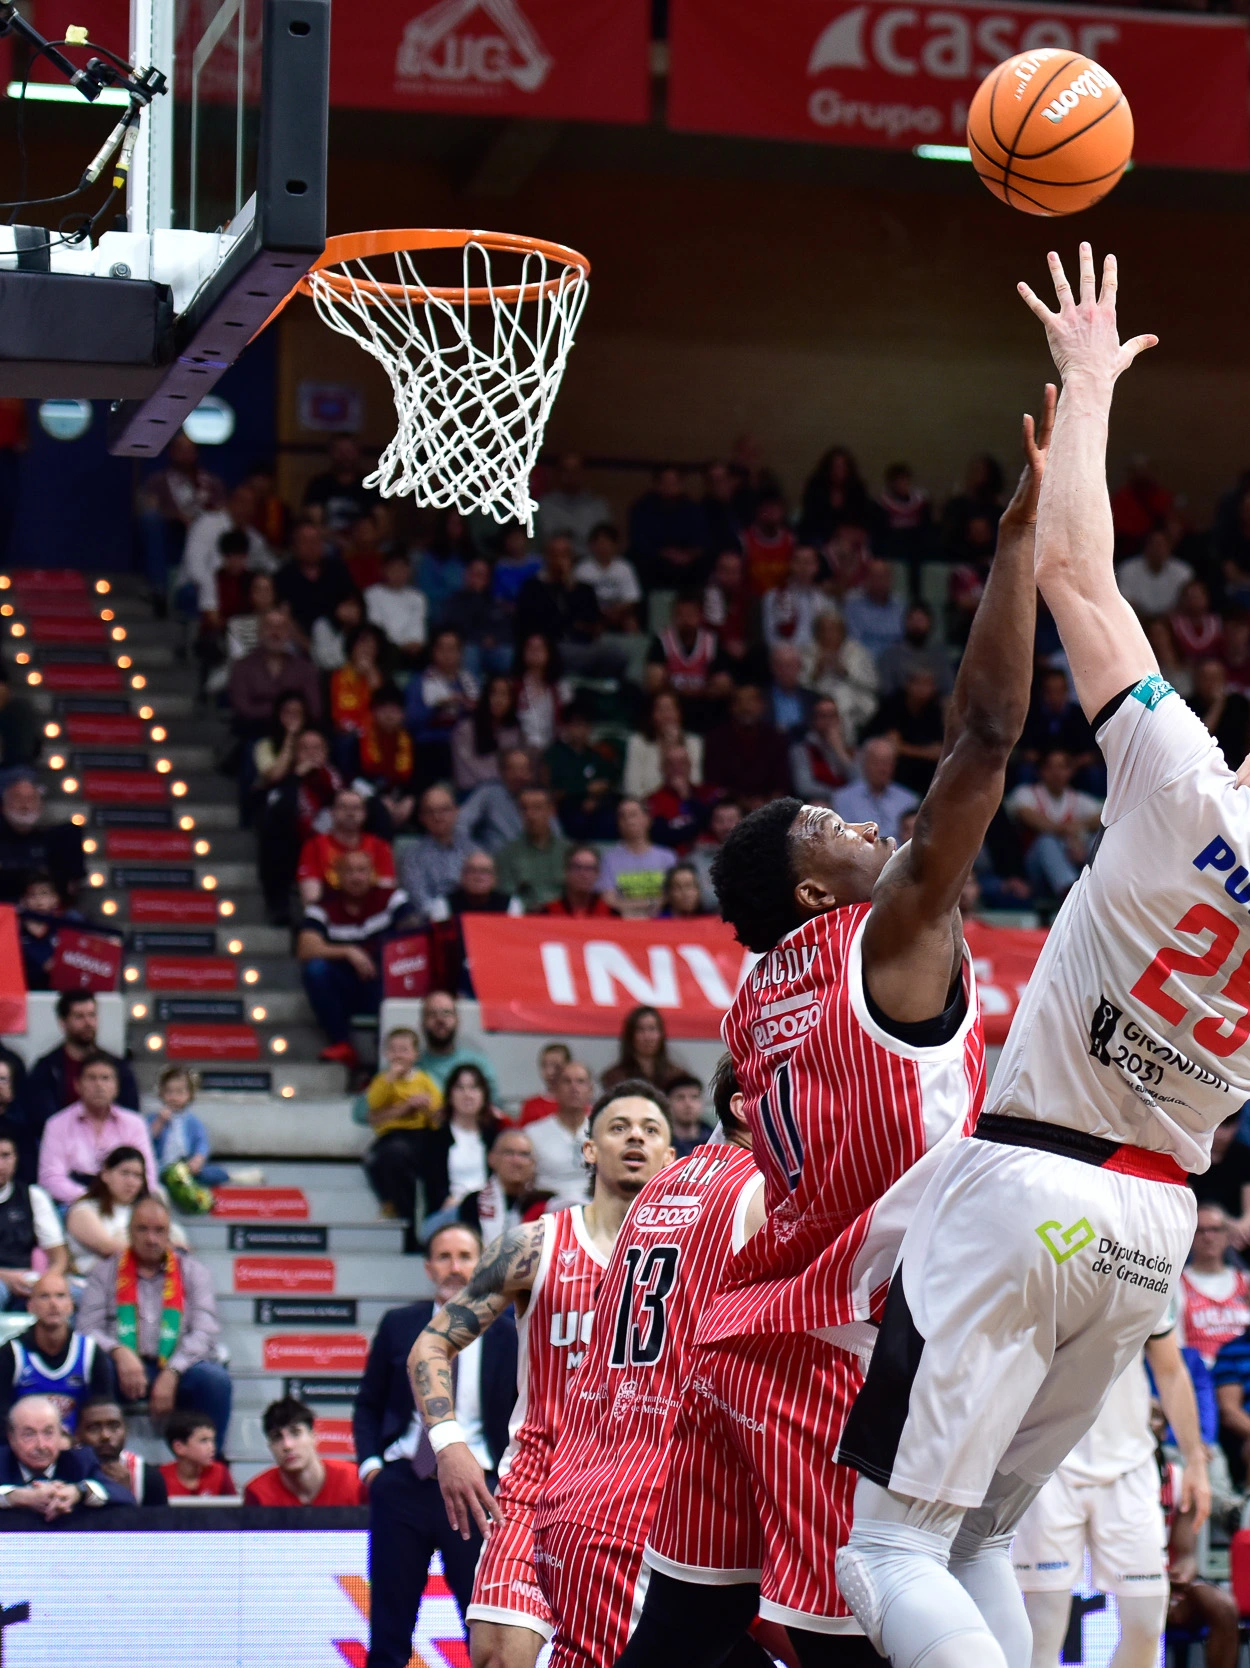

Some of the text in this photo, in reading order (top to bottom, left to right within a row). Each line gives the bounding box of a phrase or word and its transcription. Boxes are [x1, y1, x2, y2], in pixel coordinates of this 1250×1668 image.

[807, 88, 943, 137] Grupo
[1112, 1045, 1165, 1085] 2031
[1092, 1258, 1169, 1294] de Granada
[1098, 1238, 1172, 1275] Diputación
[608, 1244, 681, 1369] 13
